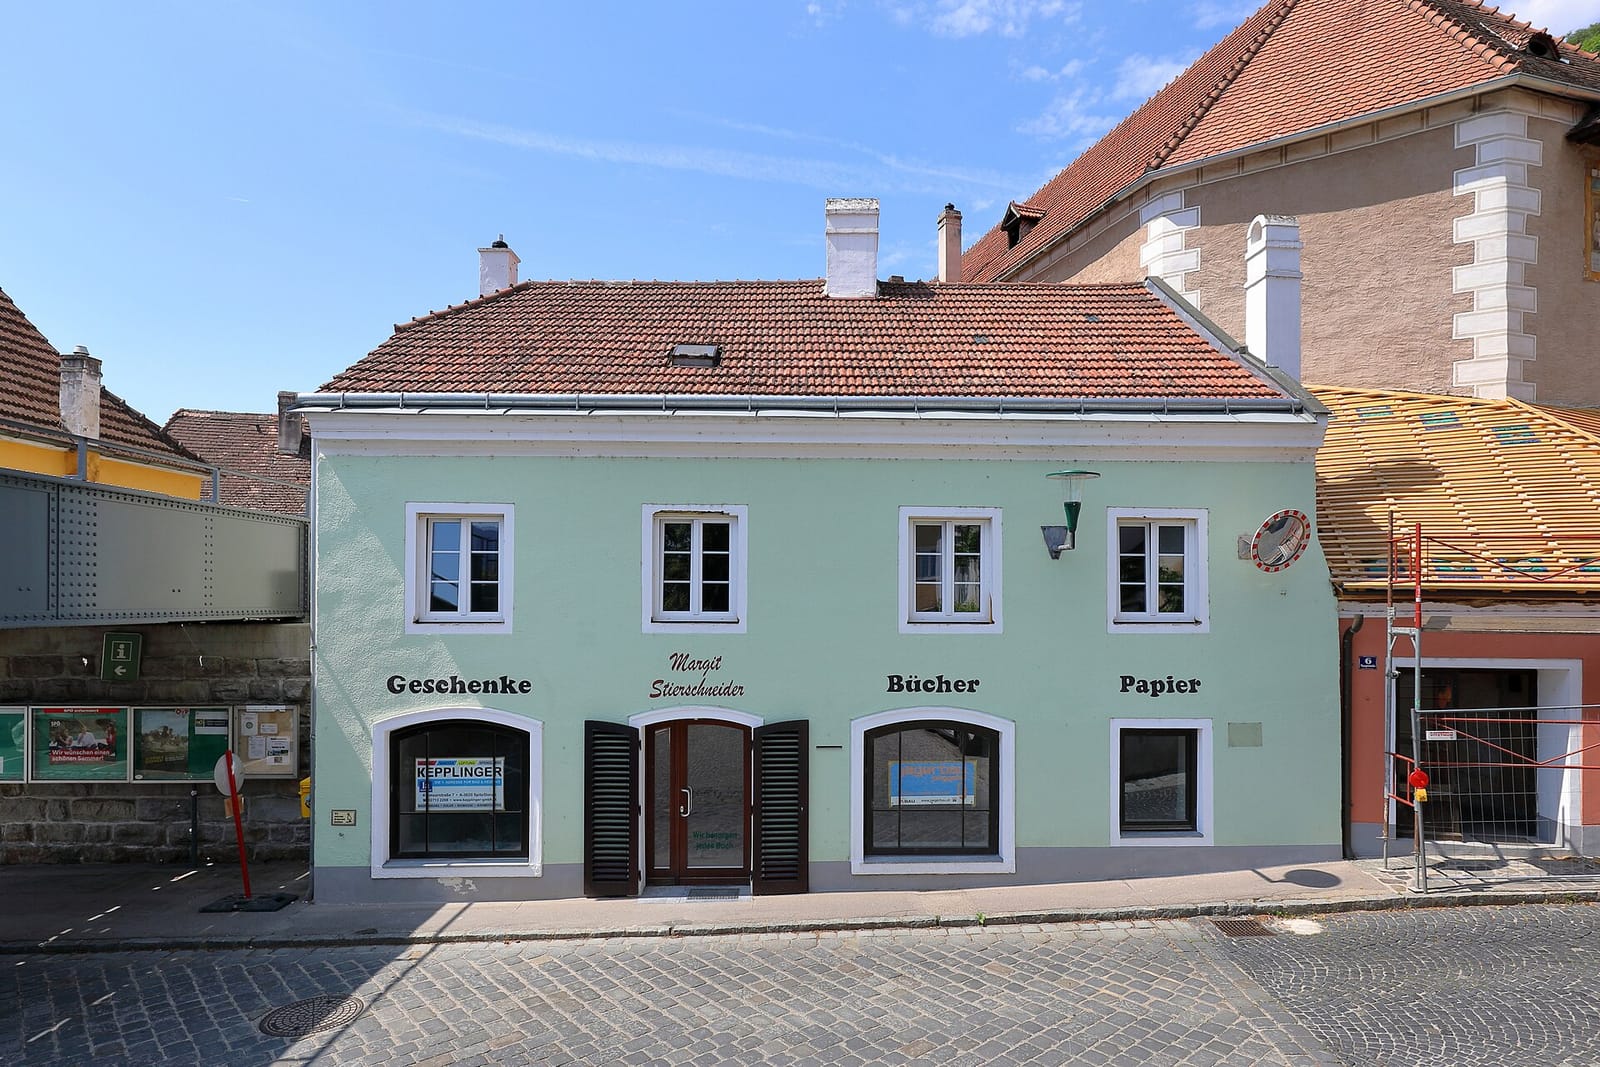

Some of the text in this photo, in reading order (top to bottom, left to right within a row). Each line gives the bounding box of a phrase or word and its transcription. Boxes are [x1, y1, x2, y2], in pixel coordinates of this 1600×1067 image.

[669, 653, 722, 677] Margit
[1365, 657, 1372, 665] 6
[386, 676, 532, 696] Geschenke
[649, 678, 744, 699] Stierschneider
[886, 674, 980, 694] Bücher
[1120, 675, 1202, 698] Papier
[417, 767, 502, 778] KEPPLINGER
